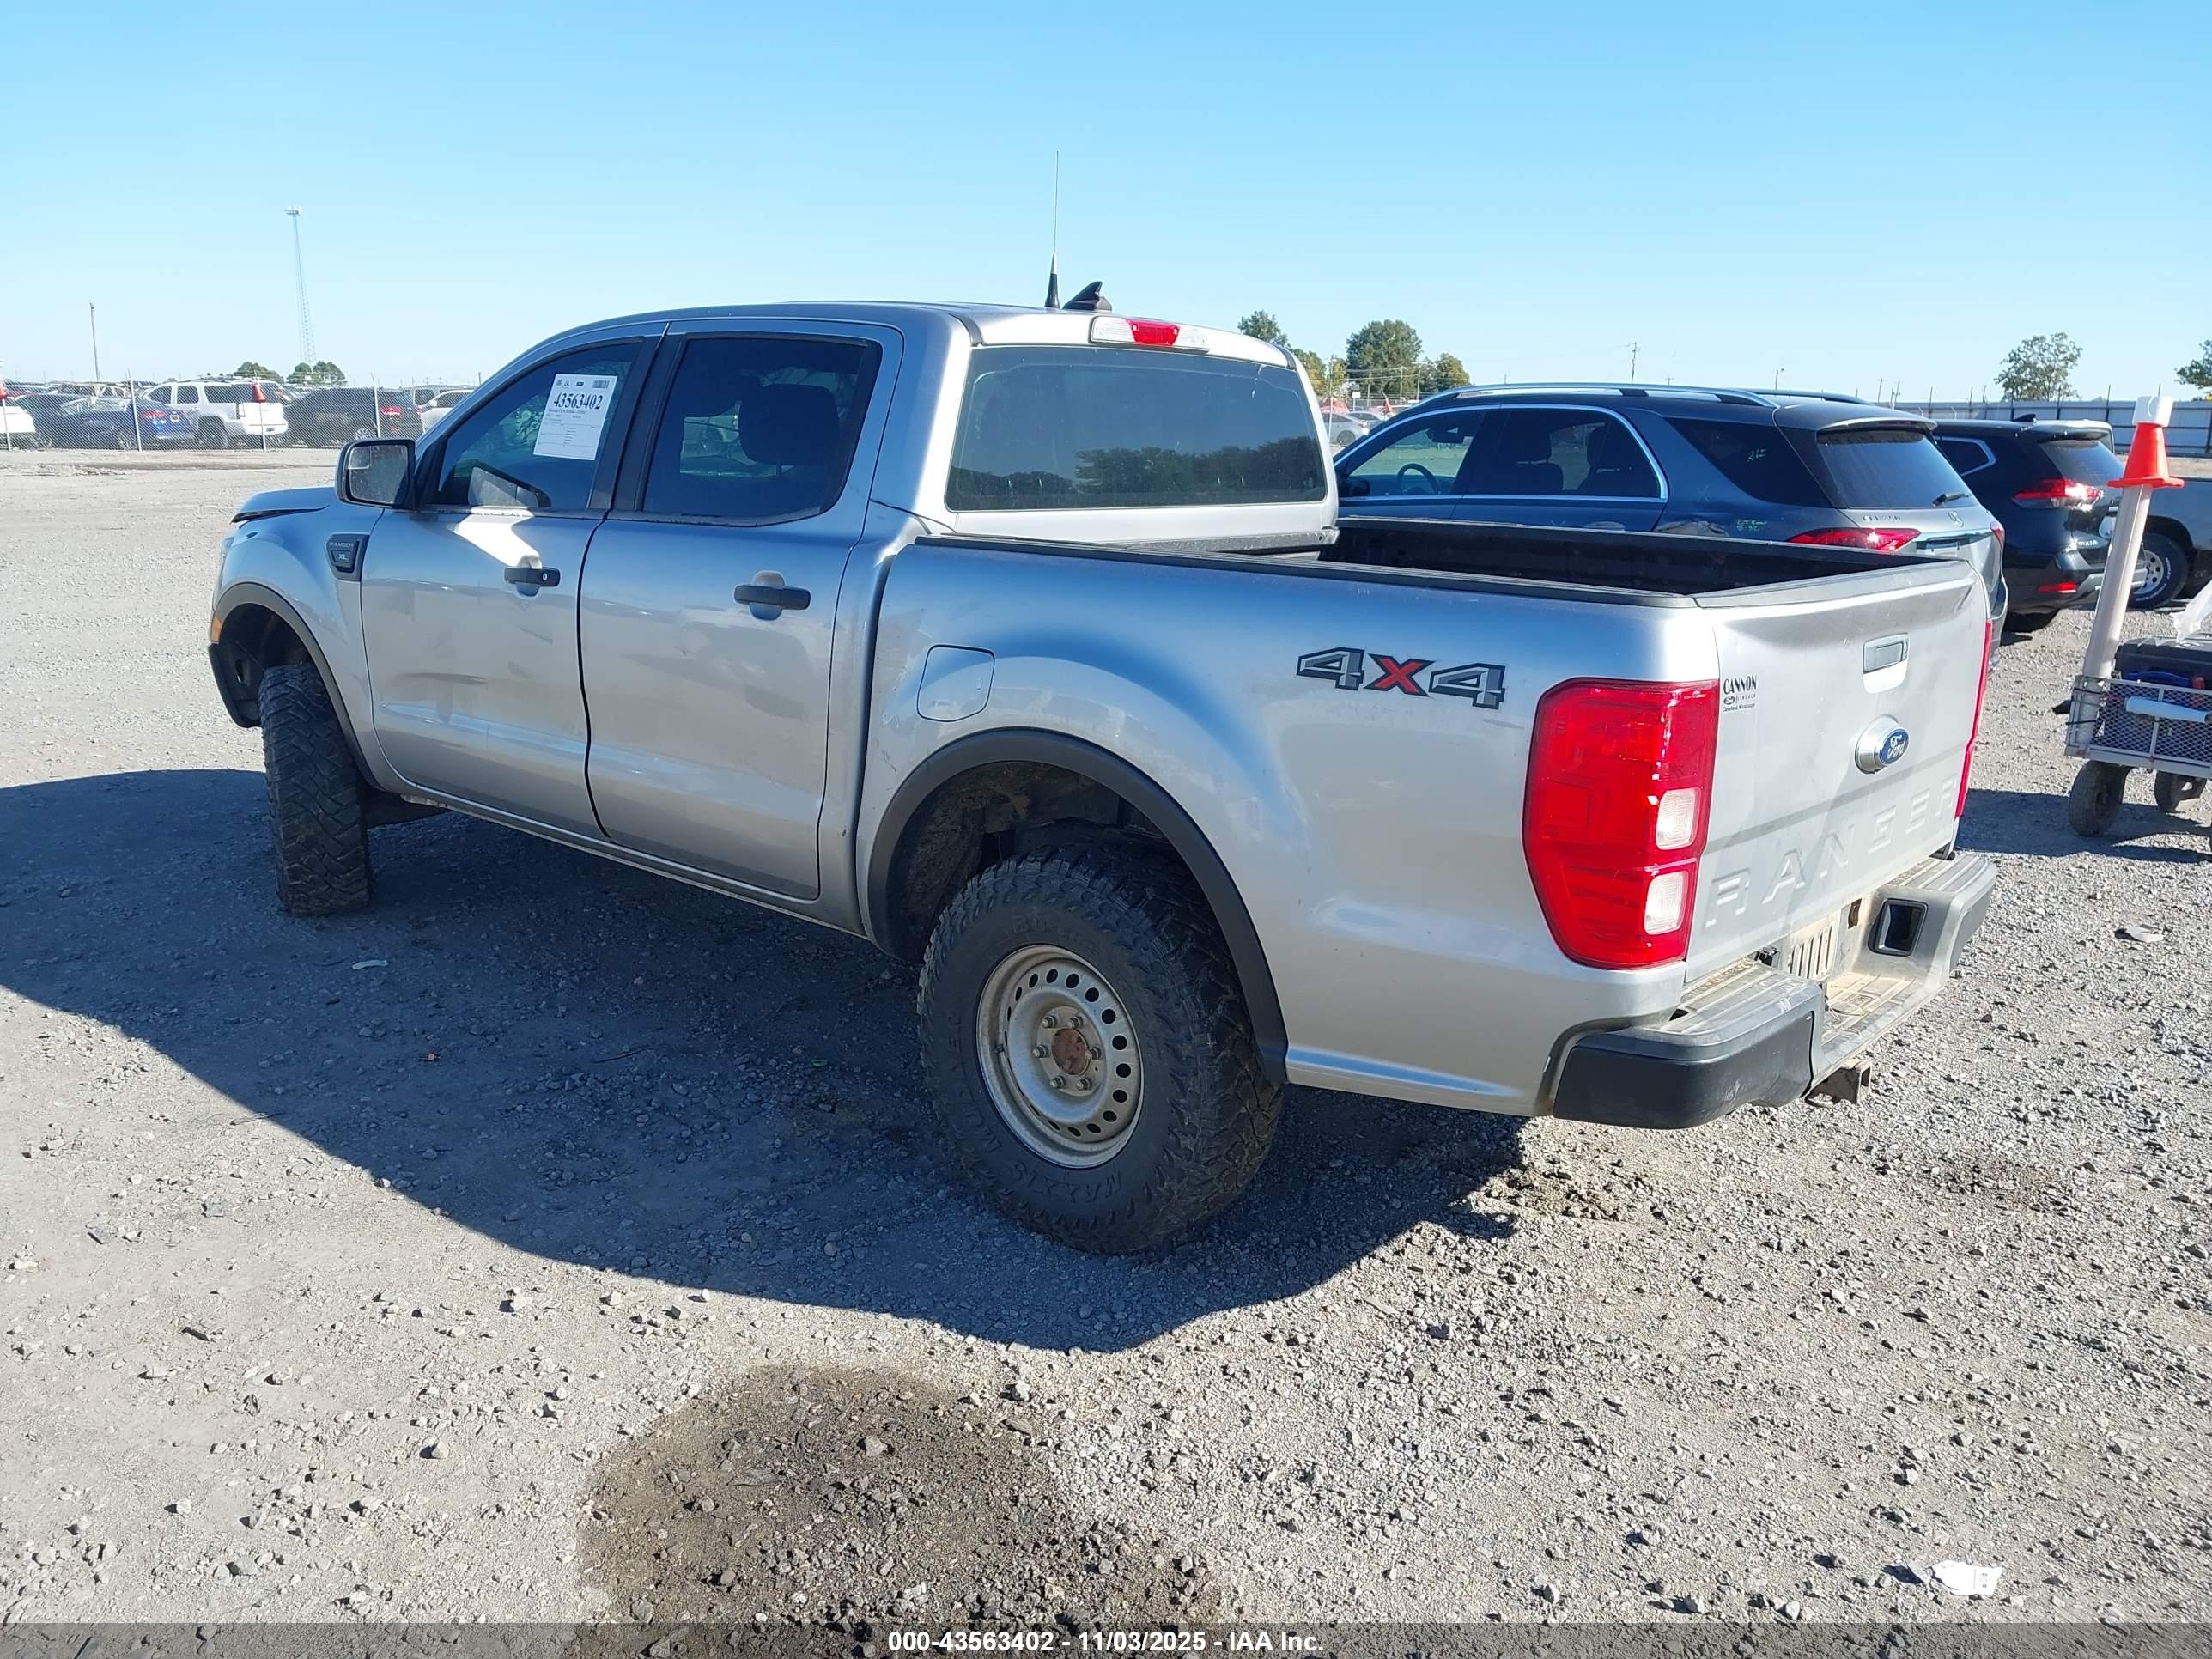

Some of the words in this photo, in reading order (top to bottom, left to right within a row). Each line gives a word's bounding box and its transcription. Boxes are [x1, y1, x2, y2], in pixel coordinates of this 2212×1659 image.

[554, 392, 604, 410] 43563402
[1297, 647, 1506, 710] 4X4
[1723, 675, 1757, 695] CANNON
[1888, 733, 1909, 761] Ford
[1705, 778, 1958, 929] RANGER
